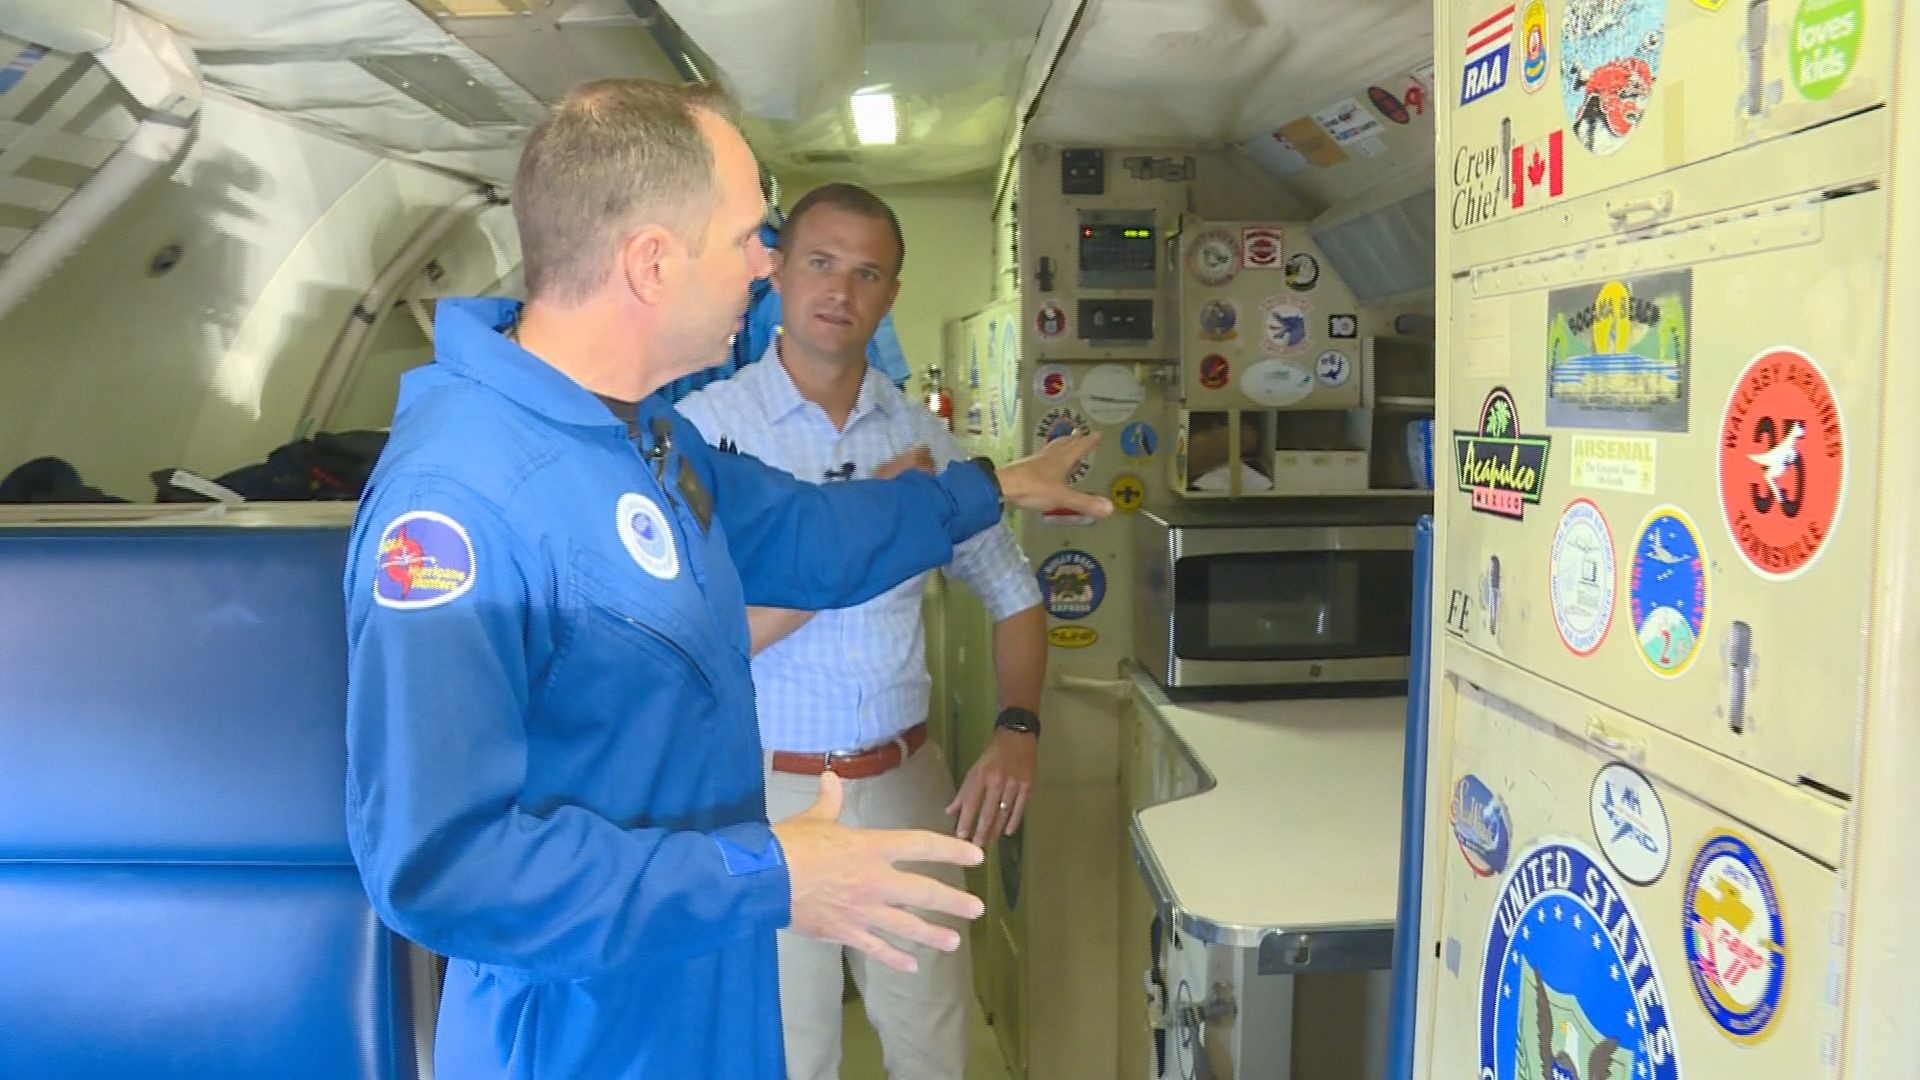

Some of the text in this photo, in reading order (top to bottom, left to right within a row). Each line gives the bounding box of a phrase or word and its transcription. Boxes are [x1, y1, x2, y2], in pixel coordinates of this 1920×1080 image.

[1798, 9, 1857, 52] loves
[1463, 53, 1502, 100] RAA
[1800, 45, 1848, 87] kids
[1454, 145, 1499, 188] Crew
[1452, 176, 1503, 230] Chief
[1619, 295, 1660, 329] BEACH
[1725, 362, 1841, 459] WALLABY AIRLINES
[1462, 439, 1536, 496] Acapulco
[1574, 438, 1653, 463] ARSENAL
[1750, 415, 1805, 519] 35
[1476, 491, 1521, 510] MEXICO
[1734, 509, 1823, 569] TOWNSVILLE
[408, 564, 466, 583] Hurricane
[410, 577, 458, 592] Hunters
[1447, 588, 1474, 633] FE
[1499, 850, 1571, 937] UNITED
[1584, 866, 1674, 1066] STATES
[1718, 927, 1765, 971] T-BIRD
[1722, 957, 1748, 987] II
